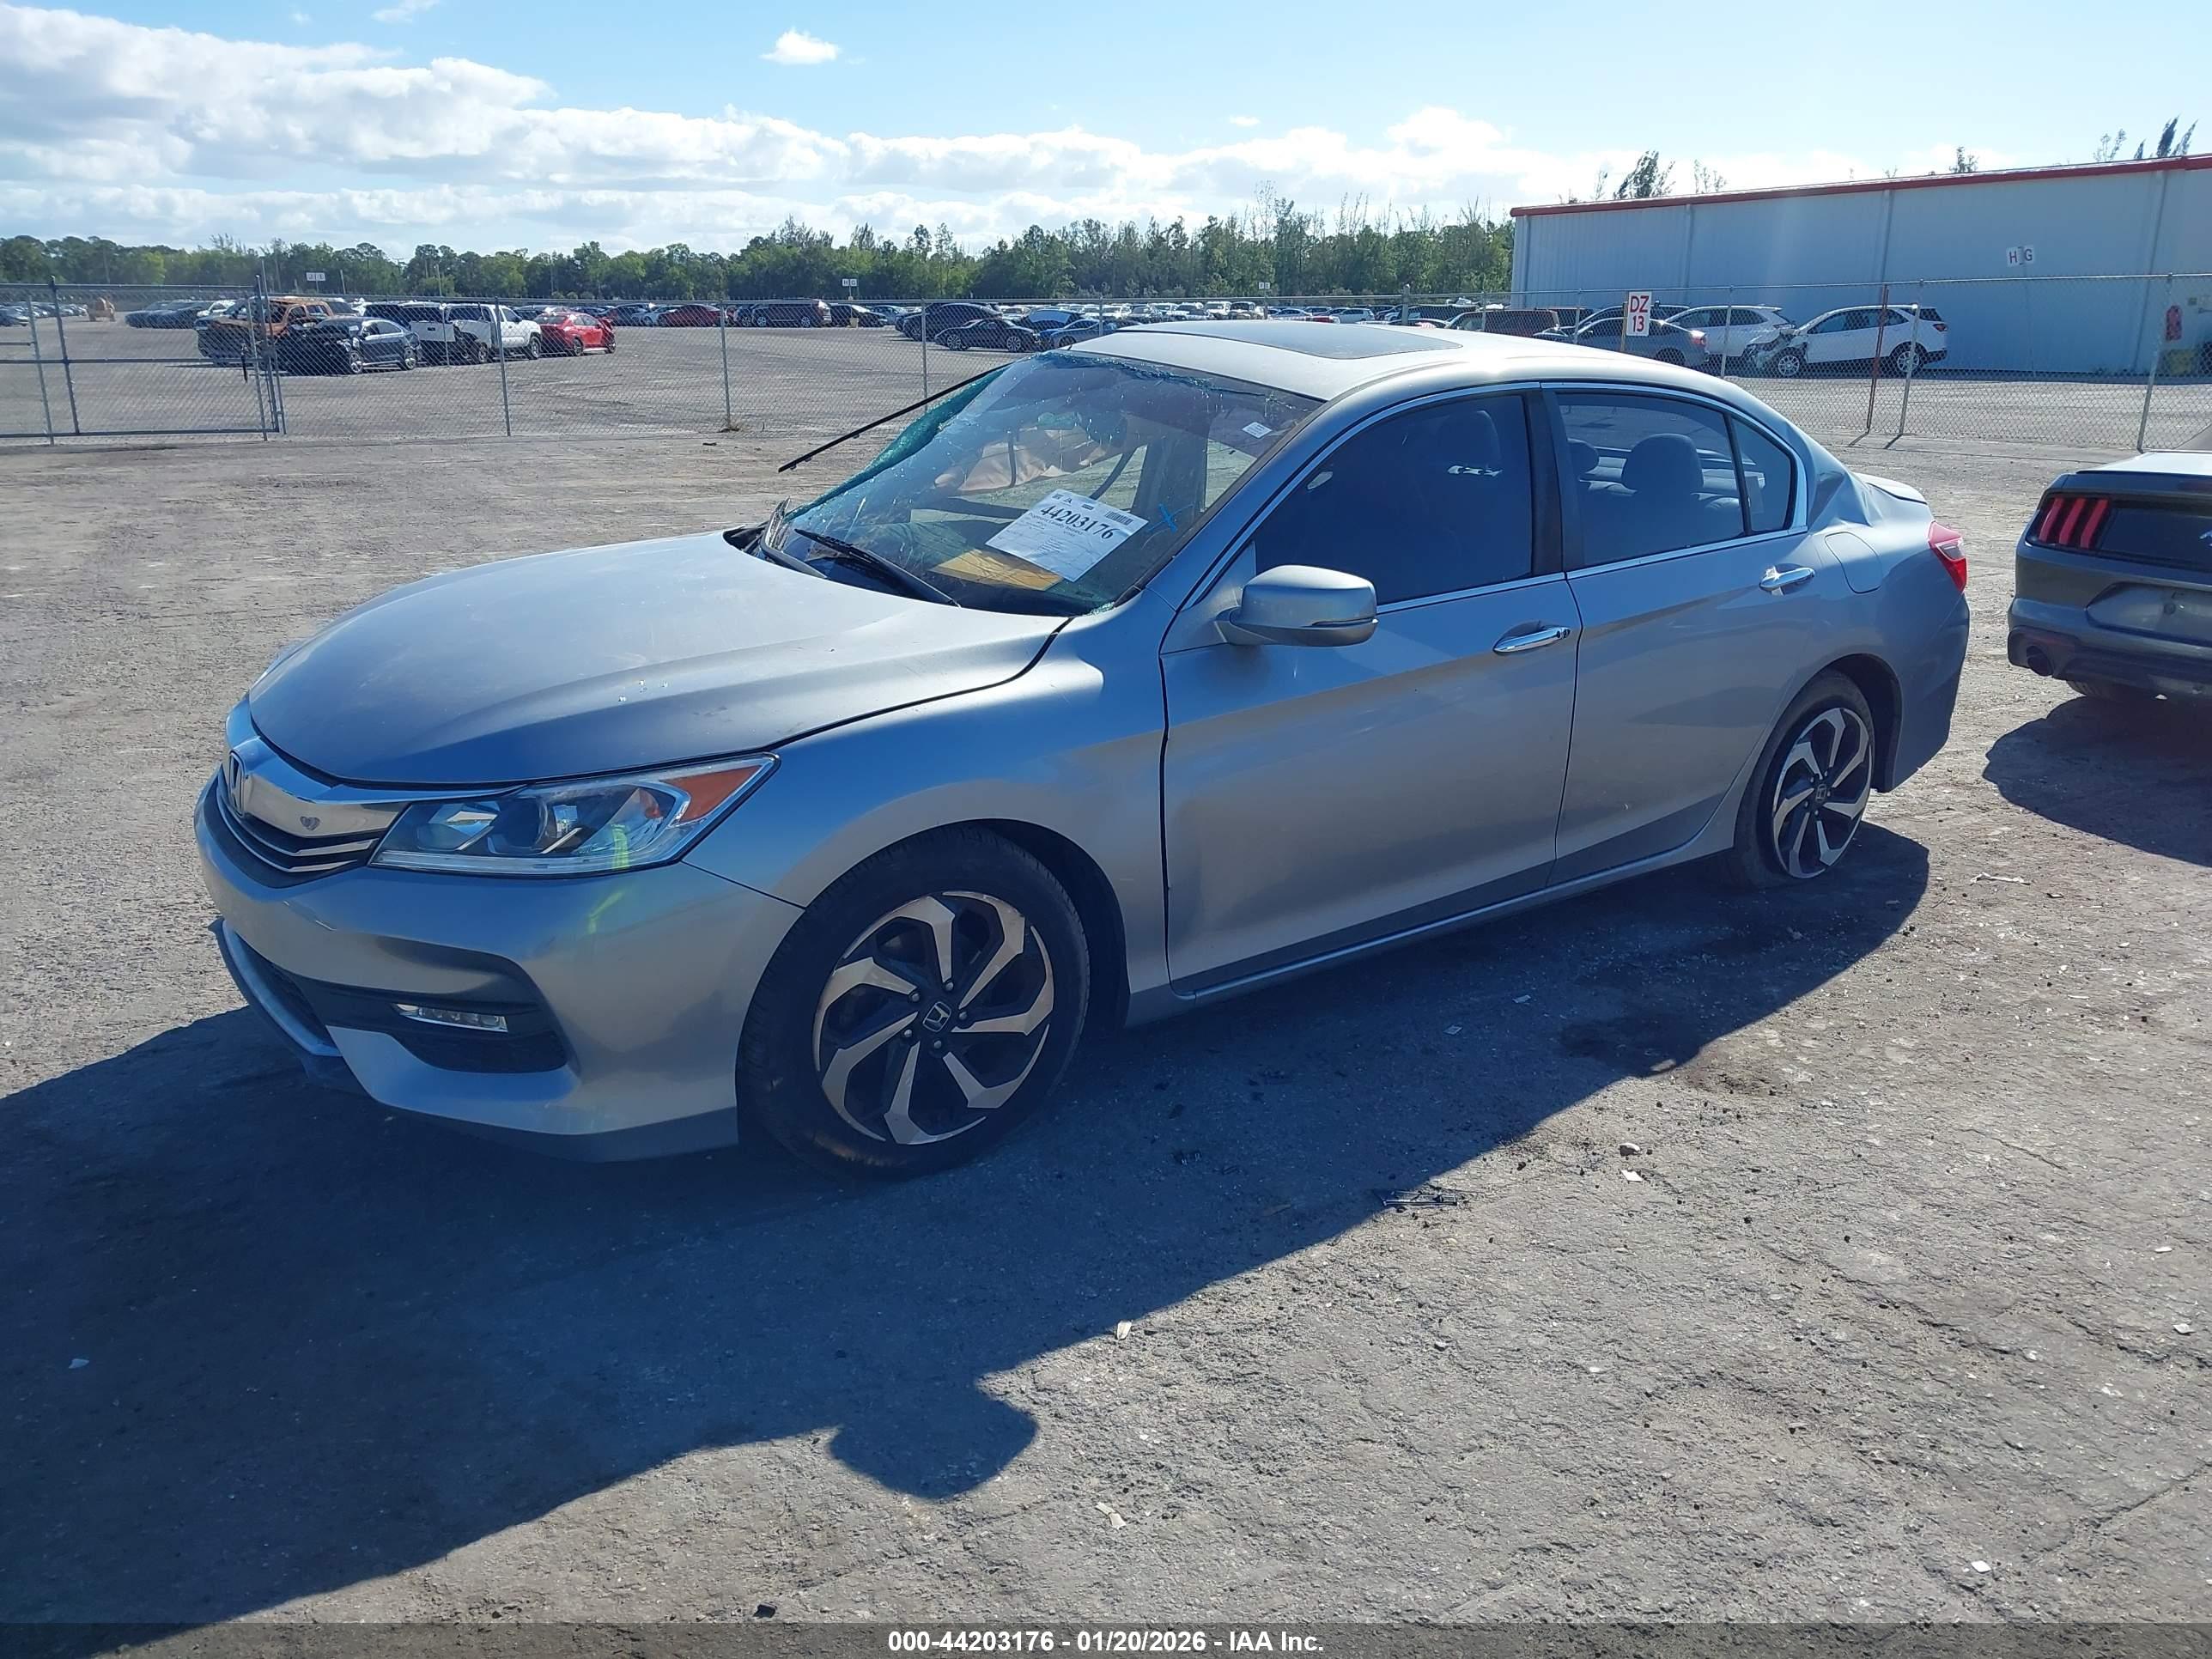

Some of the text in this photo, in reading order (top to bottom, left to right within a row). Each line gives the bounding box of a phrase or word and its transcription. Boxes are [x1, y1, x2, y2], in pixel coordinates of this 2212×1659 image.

[2009, 248, 2033, 264] H G
[1630, 295, 1650, 313] DZ
[1632, 315, 1644, 331] 13
[1041, 505, 1120, 539] 44203176
